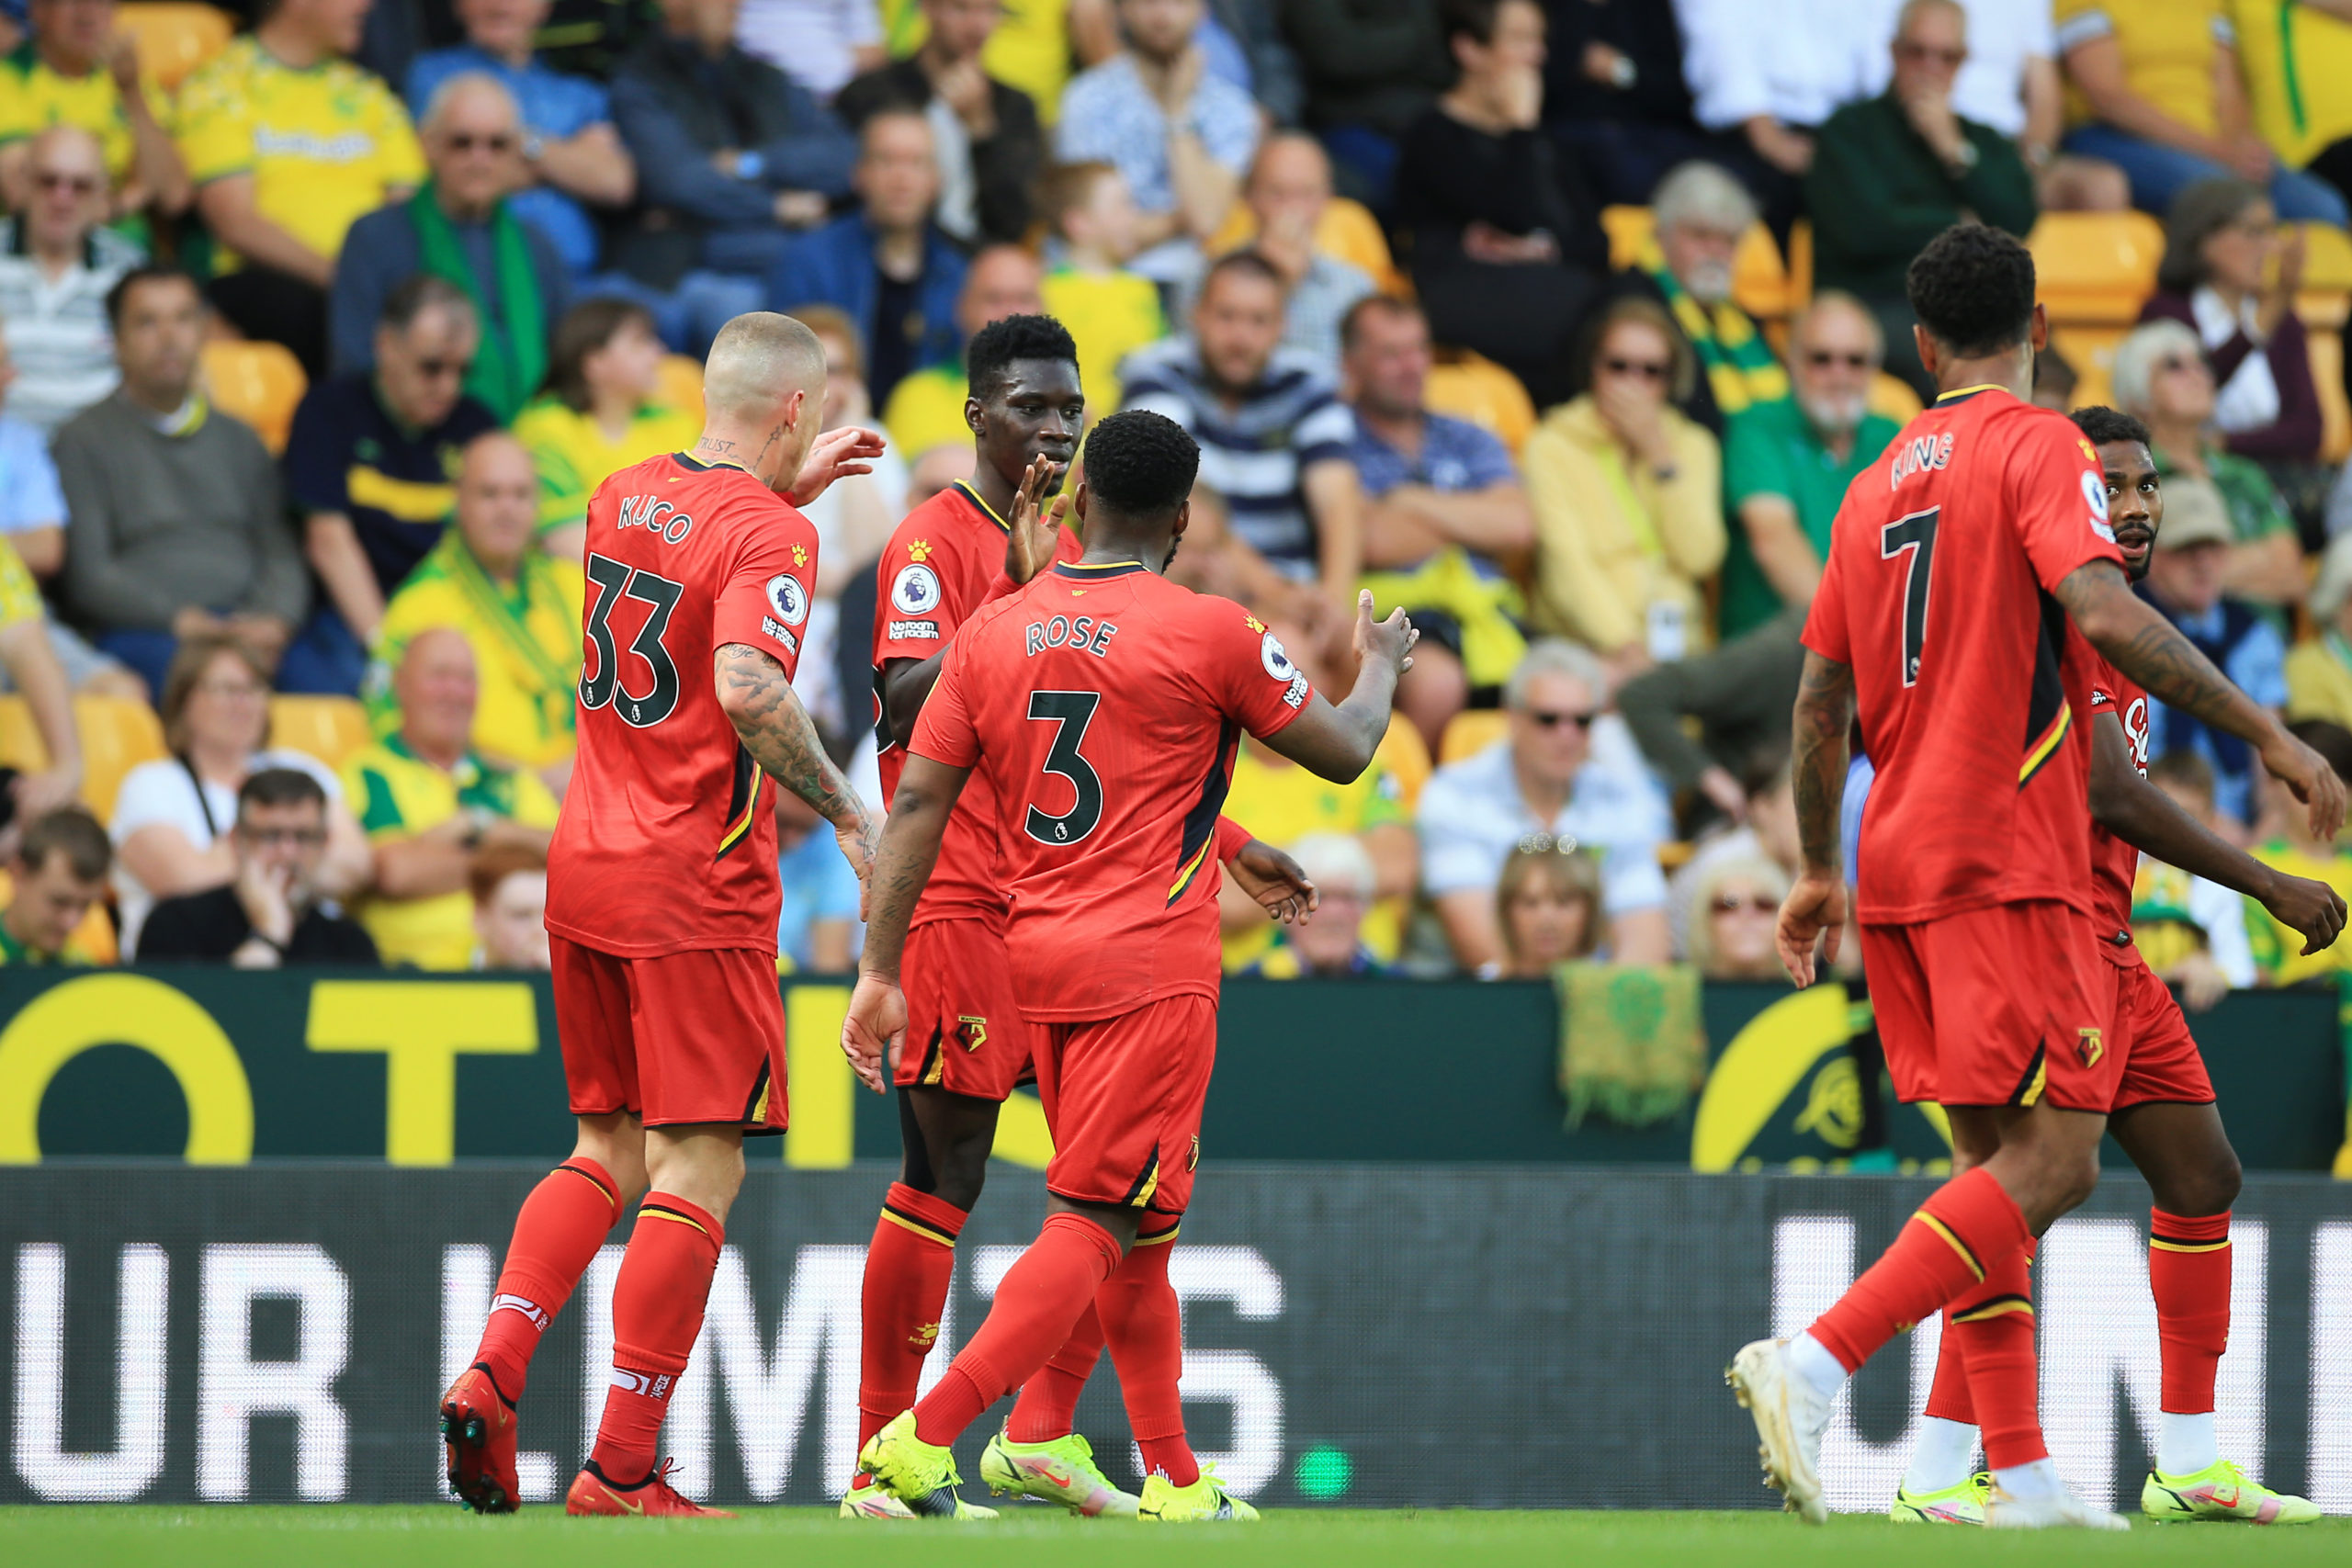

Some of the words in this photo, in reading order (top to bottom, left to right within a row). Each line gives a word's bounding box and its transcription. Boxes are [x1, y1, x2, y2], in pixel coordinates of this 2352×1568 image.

[1891, 432, 1954, 491] KING
[617, 494, 693, 545] KUCO
[579, 552, 684, 728] 33
[889, 621, 905, 631] No
[905, 621, 934, 631] room
[1026, 615, 1118, 658] ROSE
[1882, 504, 1941, 689] 7
[1024, 691, 1103, 846] 3
[10, 1242, 352, 1504] UR
